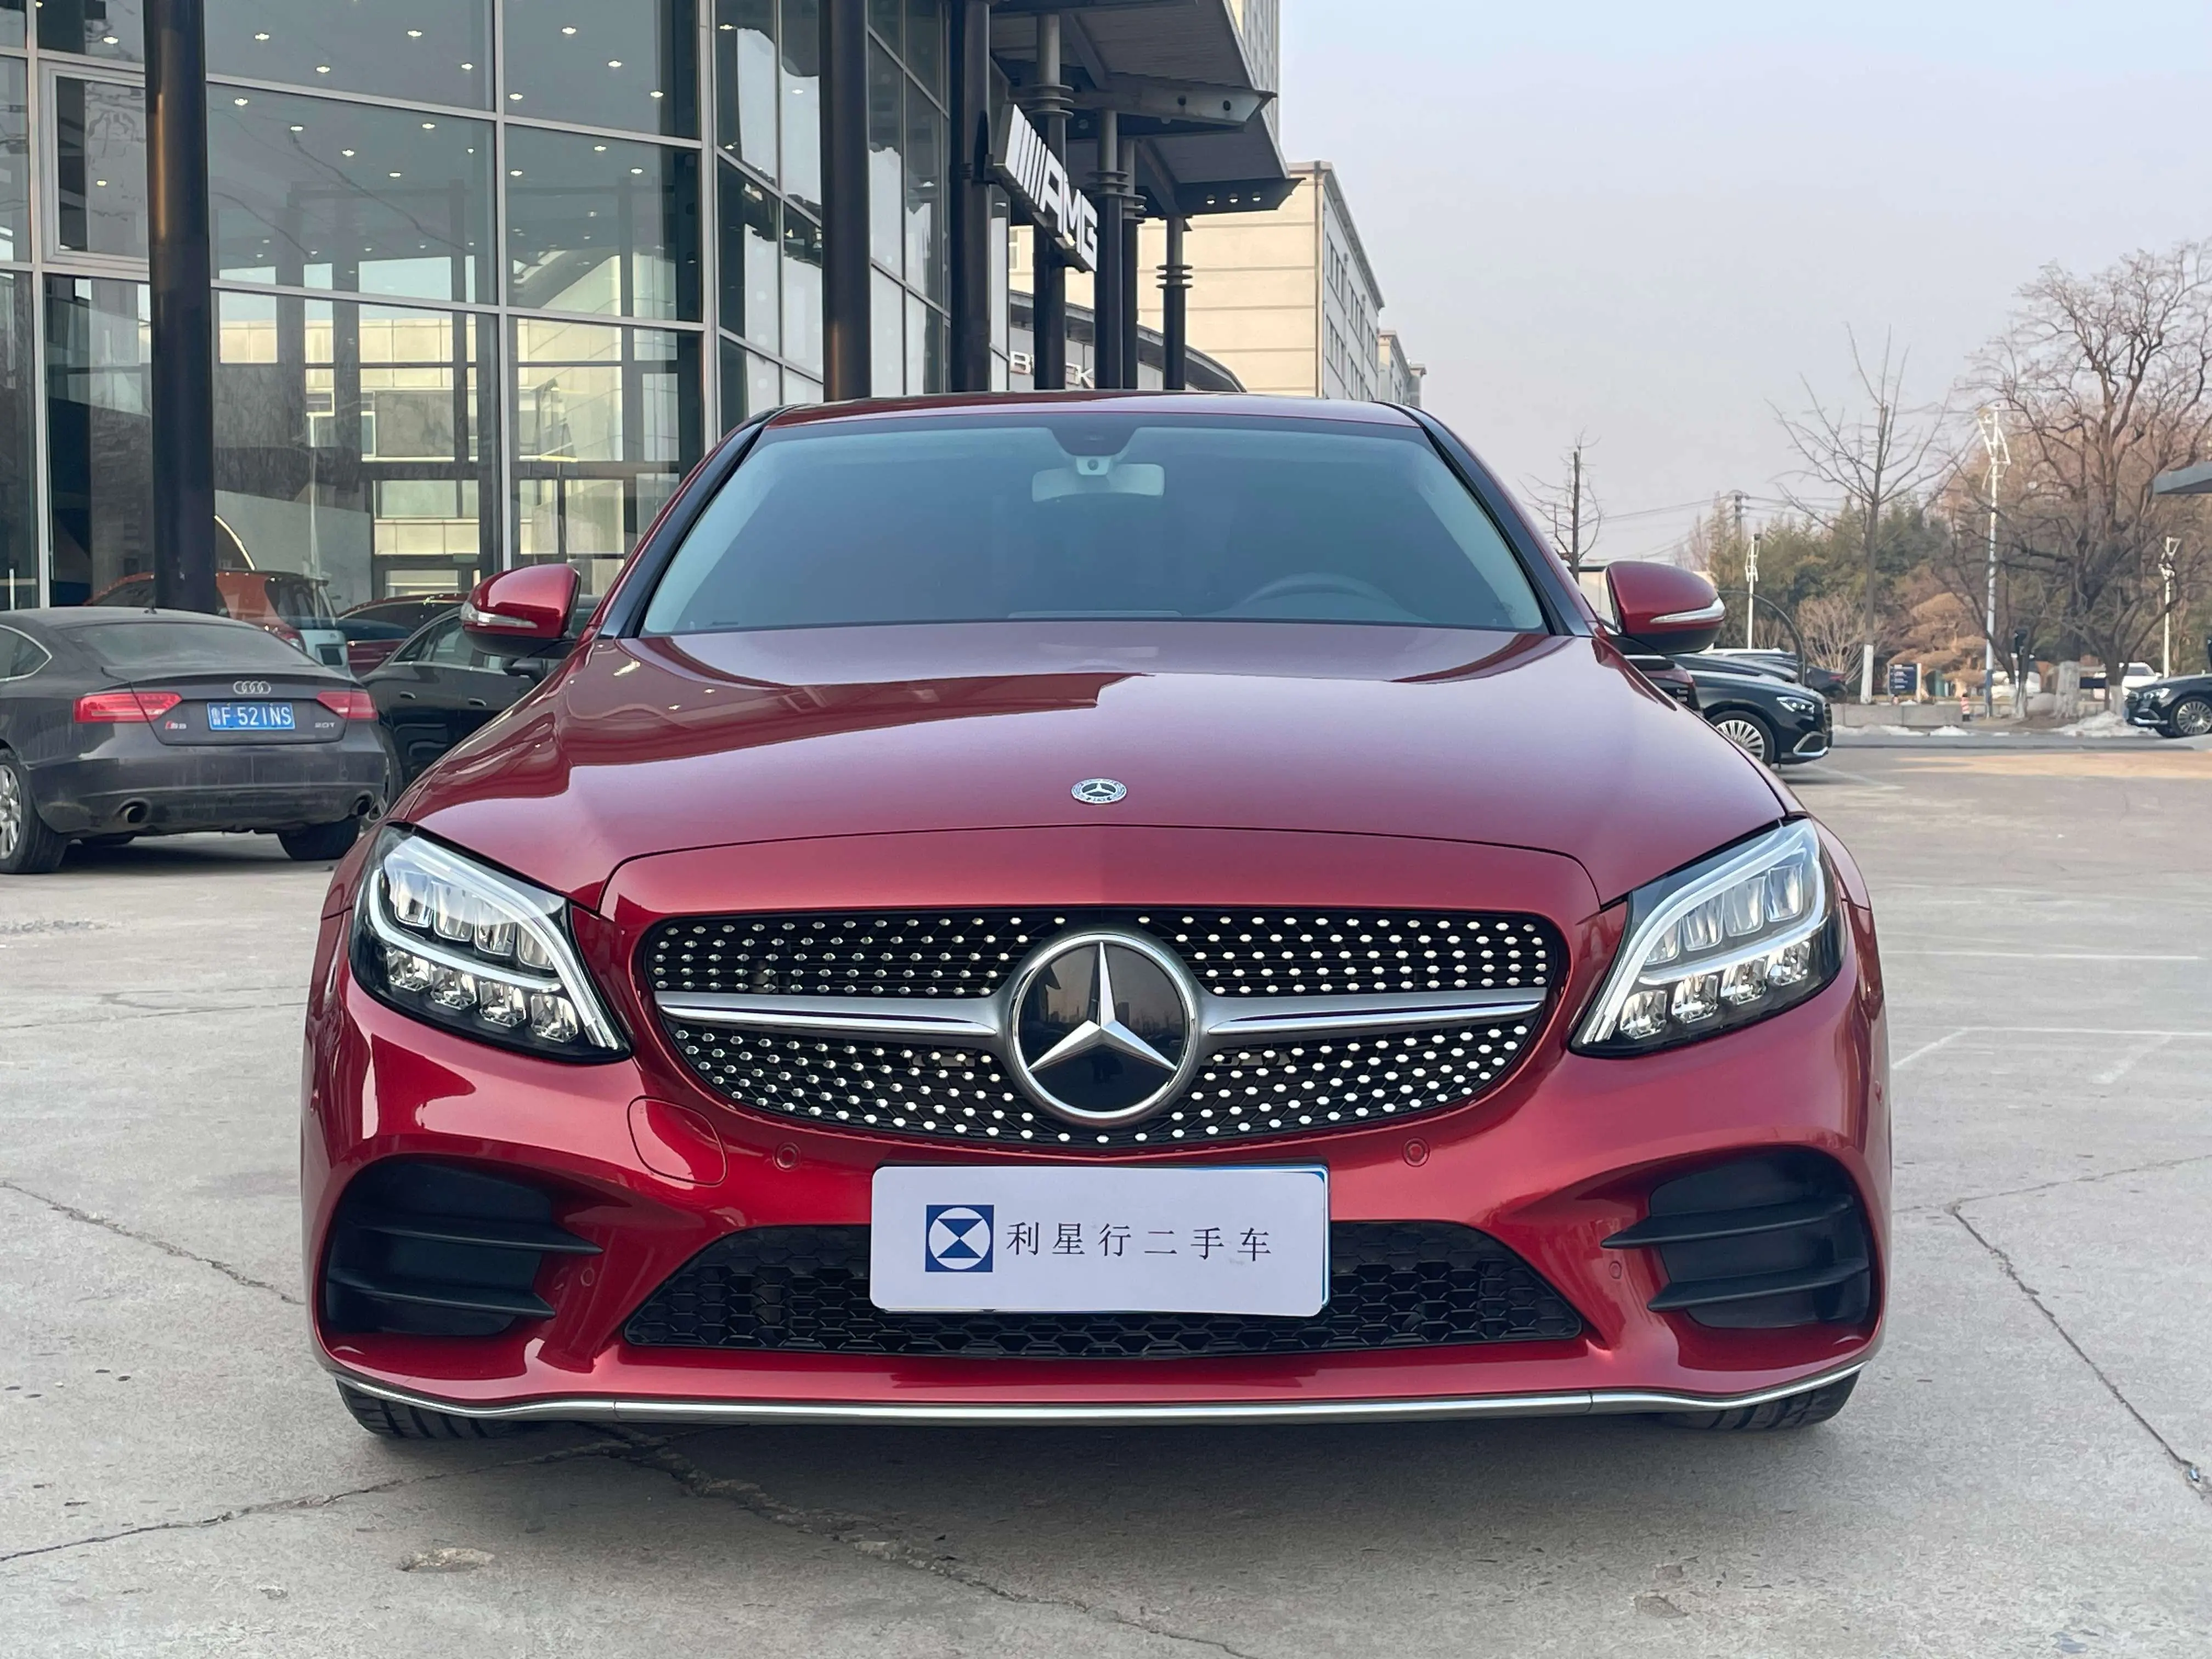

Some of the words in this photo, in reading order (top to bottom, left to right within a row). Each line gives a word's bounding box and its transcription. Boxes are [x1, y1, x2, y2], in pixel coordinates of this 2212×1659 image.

[1006, 1221, 1271, 1262] 利星行二手车
